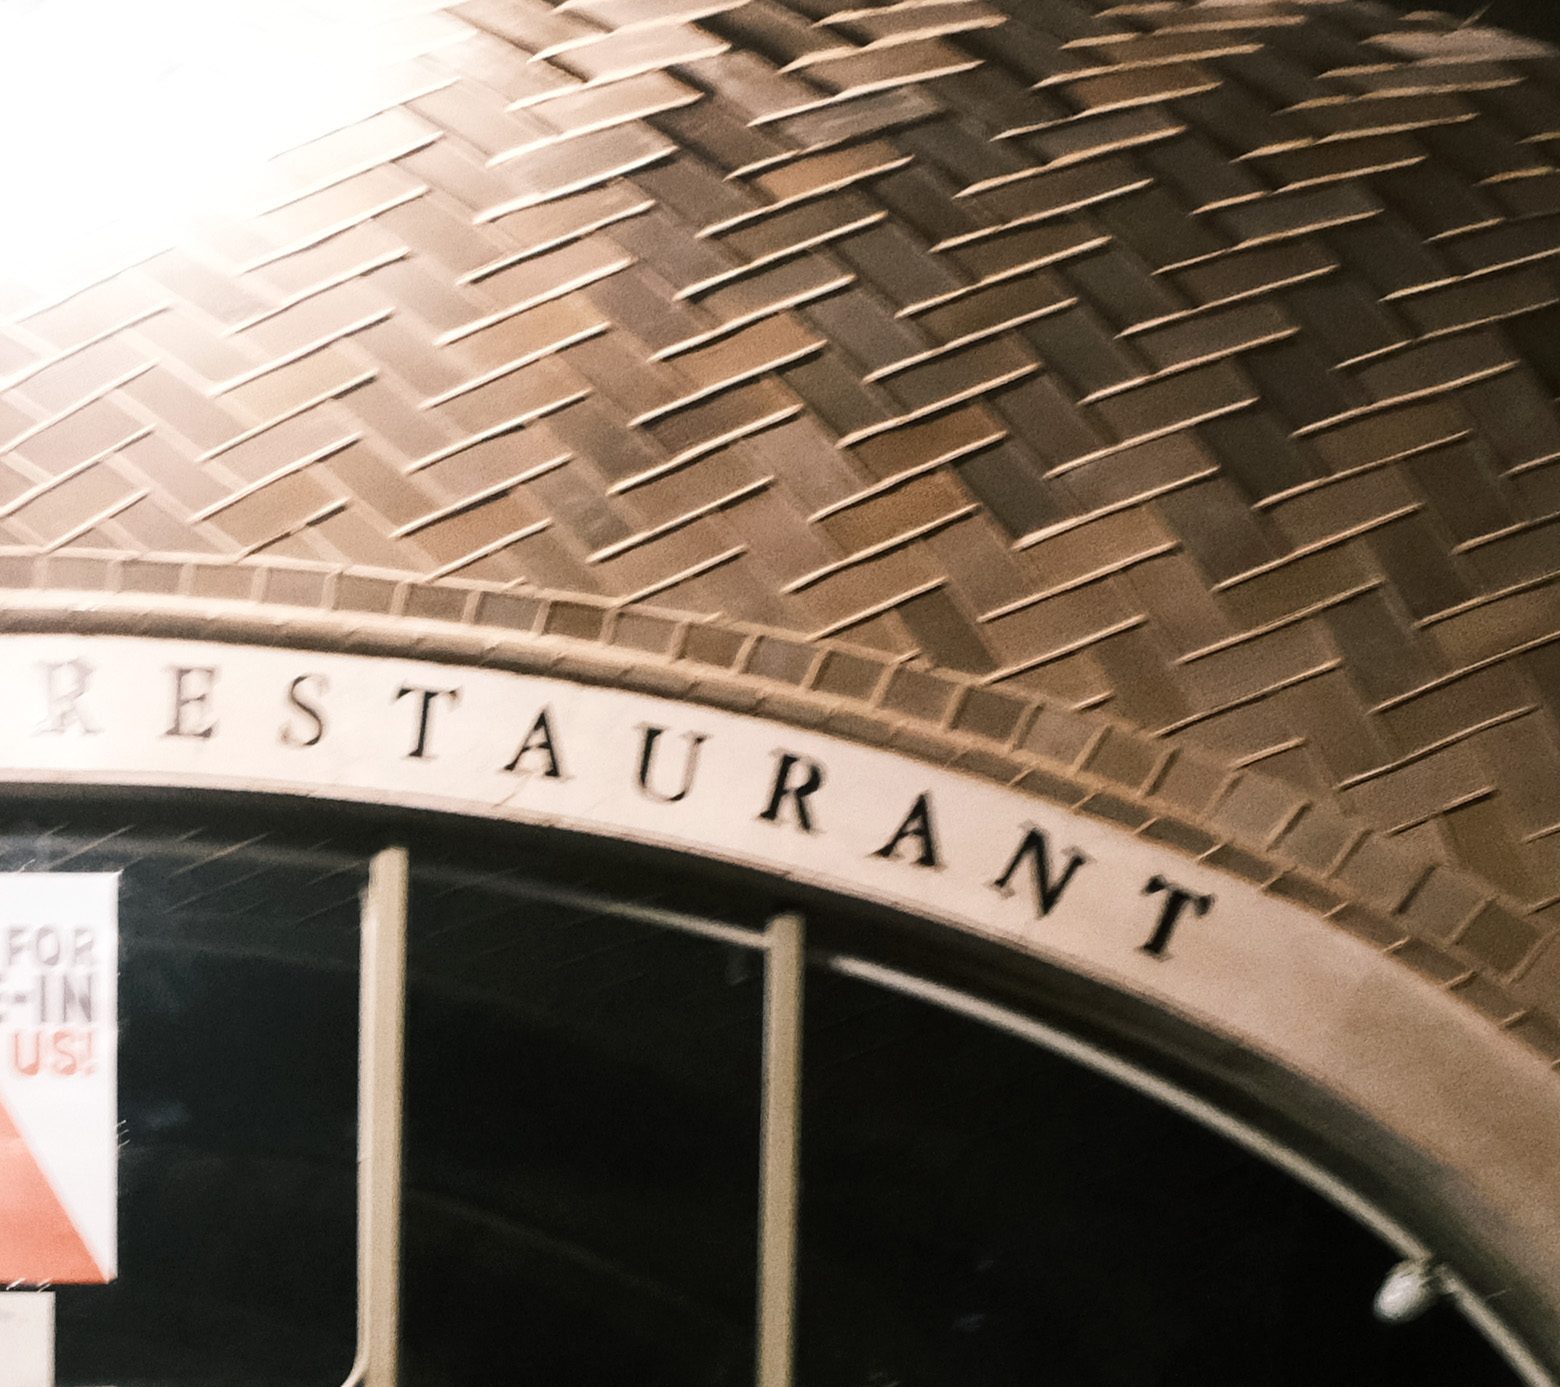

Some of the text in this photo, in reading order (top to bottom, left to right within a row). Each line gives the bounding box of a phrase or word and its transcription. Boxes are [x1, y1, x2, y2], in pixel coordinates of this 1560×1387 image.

[35, 658, 1218, 962] RESTAURANT
[5, 925, 96, 966] FOR
[12, 1029, 96, 1076] US!
